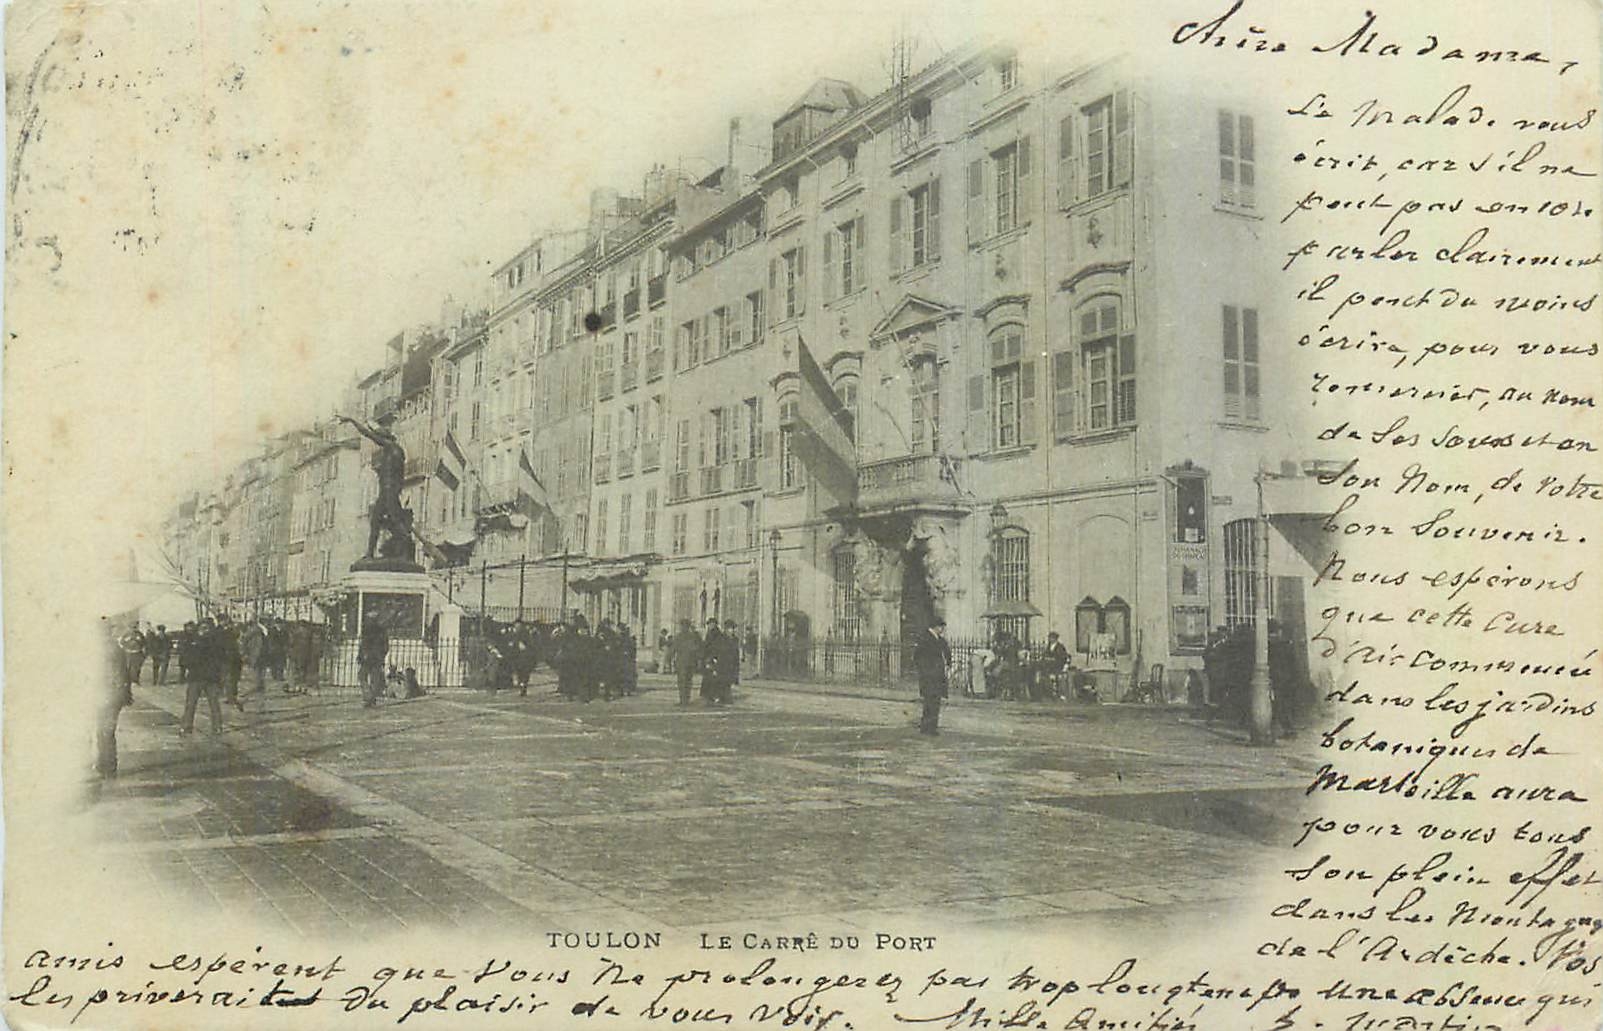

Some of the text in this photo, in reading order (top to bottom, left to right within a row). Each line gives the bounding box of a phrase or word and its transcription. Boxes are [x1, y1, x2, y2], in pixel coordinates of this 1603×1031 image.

[1513, 108, 1597, 132] vous
[1379, 198, 1459, 236] pas
[1282, 229, 1418, 271] parler
[1297, 274, 1340, 301] il
[1439, 288, 1479, 308] du
[1495, 294, 1599, 312] moins
[1413, 342, 1500, 366] pour
[1518, 342, 1600, 357] vous
[1498, 387, 1533, 403] au
[1317, 422, 1362, 441] de
[1490, 468, 1524, 491] de
[1312, 550, 1410, 587] Nous
[1312, 606, 1394, 640] que
[1407, 602, 1474, 628] cette
[1325, 681, 1597, 739] dans les jardins
[1506, 733, 1578, 758] de
[1305, 763, 1589, 802] Marseille aura
[1293, 817, 1593, 848] pour vous tous
[1372, 851, 1490, 898] plein
[1506, 847, 1603, 909] effet
[1270, 898, 1377, 919] dans
[1257, 937, 1307, 957] de
[23, 942, 125, 971] amis
[373, 965, 457, 999] que
[918, 968, 989, 997] pas
[1008, 965, 1081, 1005] trop
[9, 975, 73, 1007] les
[395, 985, 549, 1024] plaisir
[639, 1001, 734, 1025] vous
